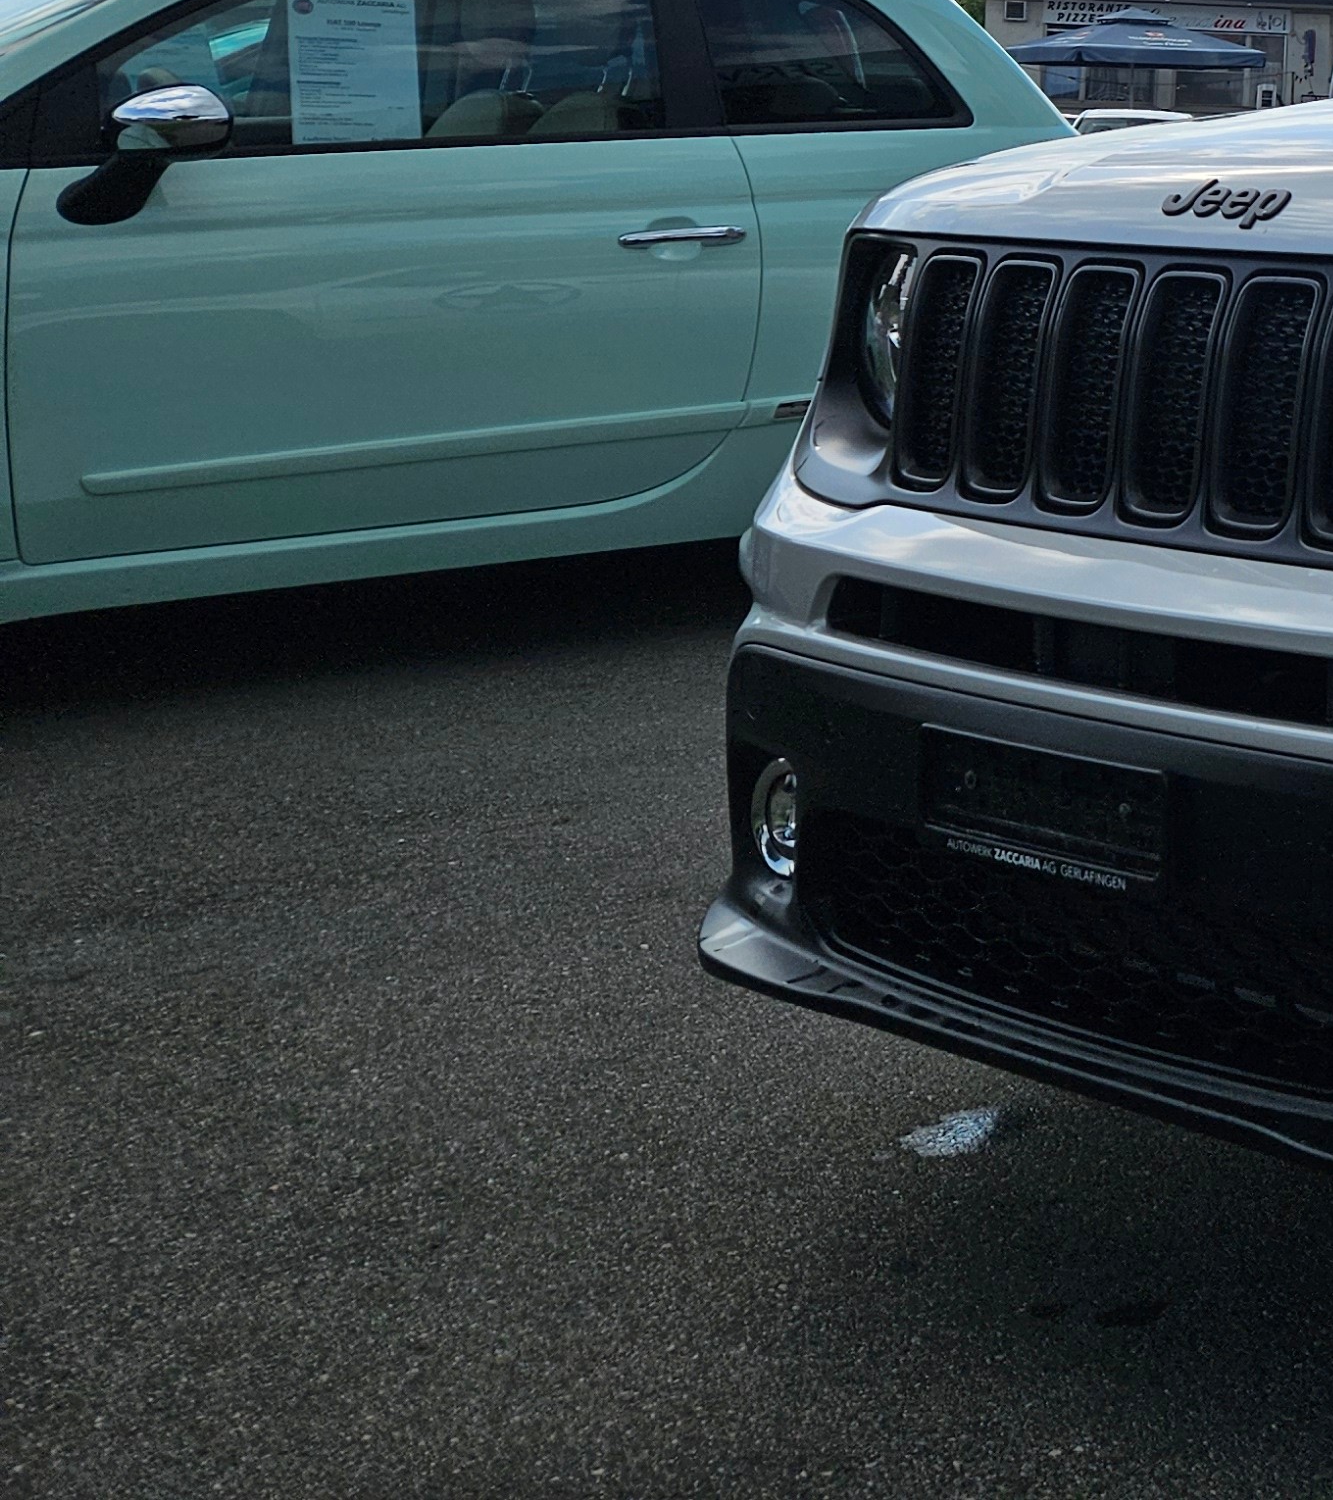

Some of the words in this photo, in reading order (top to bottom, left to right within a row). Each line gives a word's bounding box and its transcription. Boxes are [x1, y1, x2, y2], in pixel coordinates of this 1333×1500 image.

[1161, 178, 1292, 230] Jeep
[947, 837, 993, 859] AUTOWERK
[993, 847, 1041, 872] ZACCARIA
[1042, 860, 1056, 875] AG
[1060, 864, 1127, 891] GERLAFINGEN
